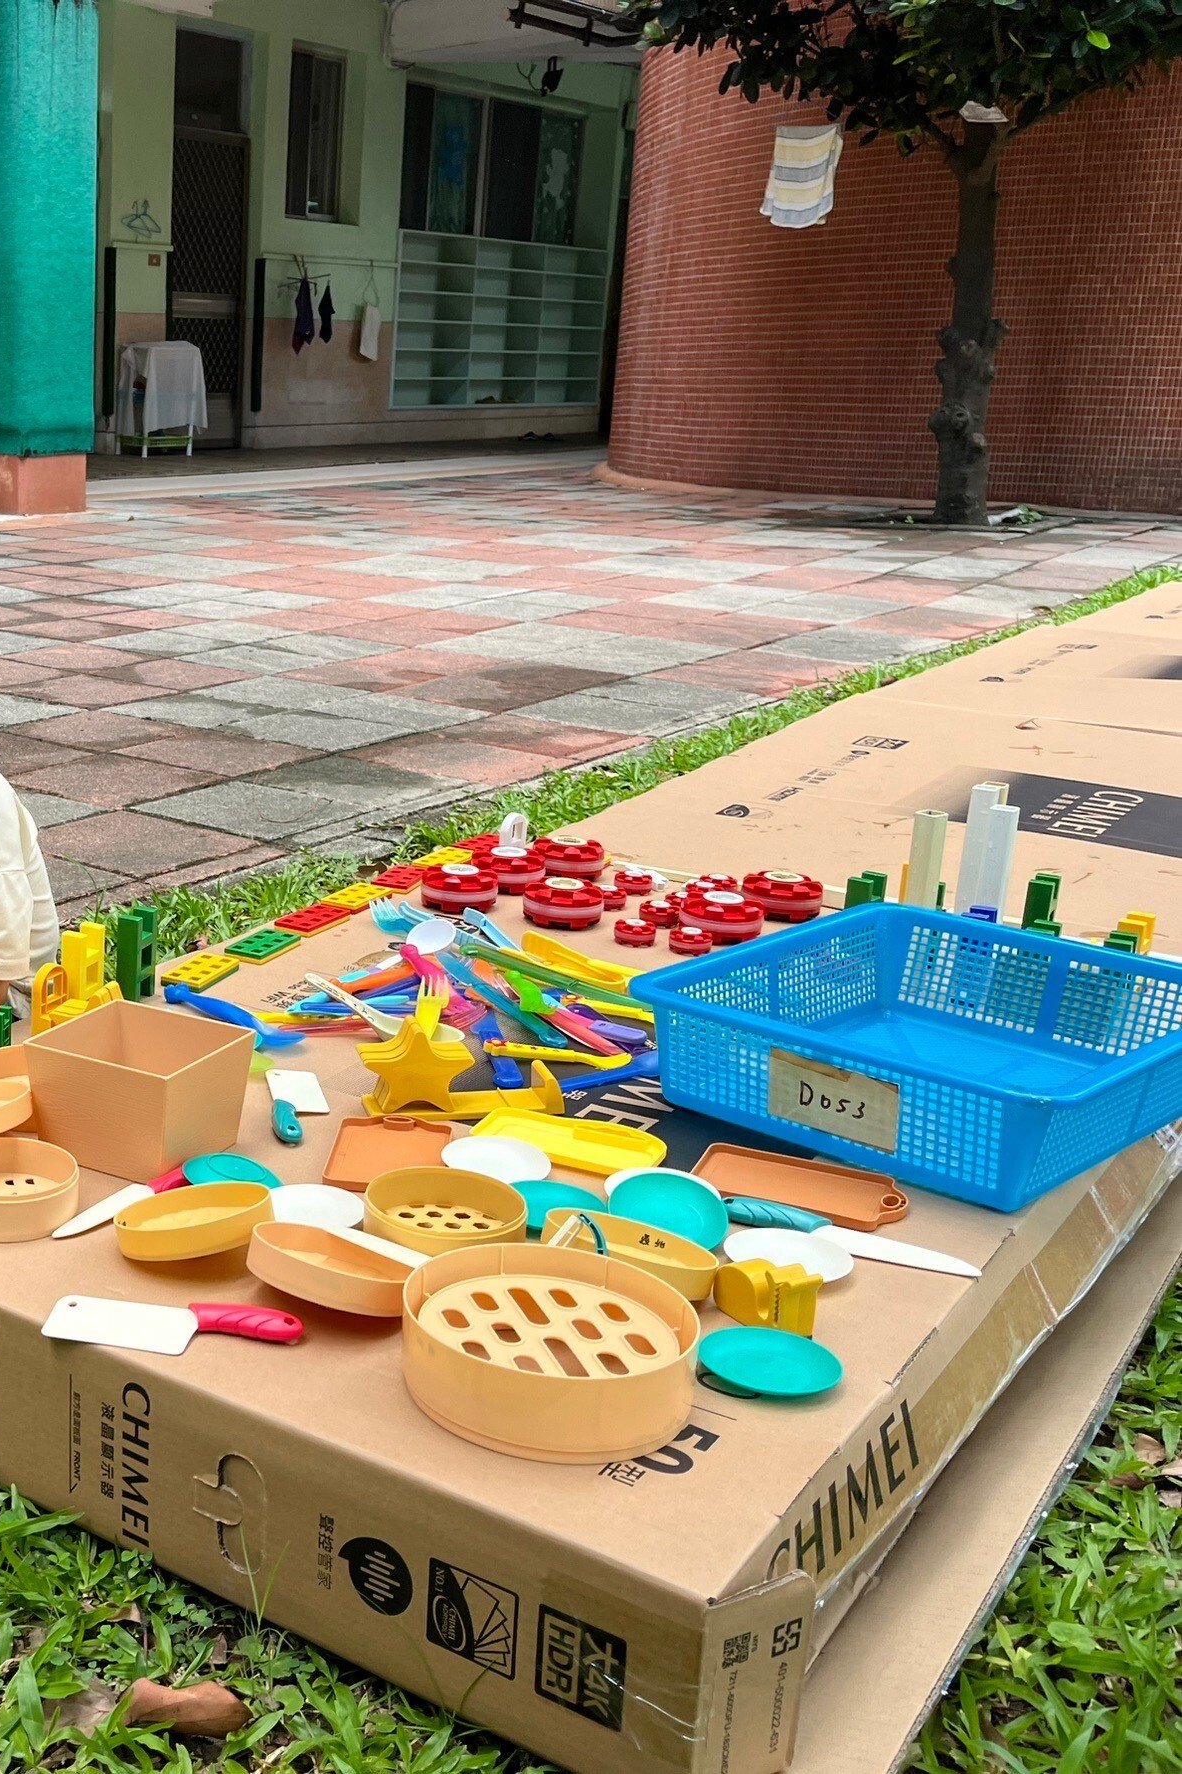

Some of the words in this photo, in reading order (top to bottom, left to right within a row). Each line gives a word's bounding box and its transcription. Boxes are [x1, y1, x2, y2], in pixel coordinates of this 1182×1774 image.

[1046, 790, 1144, 838] CHIMEI
[73, 1451, 81, 1481] FRONT
[100, 1402, 115, 1499] 液晶顯示器
[122, 1382, 150, 1548] CHIMEI
[318, 1513, 334, 1590] 聲控管家
[436, 1567, 445, 1593] NO.1
[447, 1608, 456, 1641] CHIMEI
[546, 1623, 575, 1694] HDR
